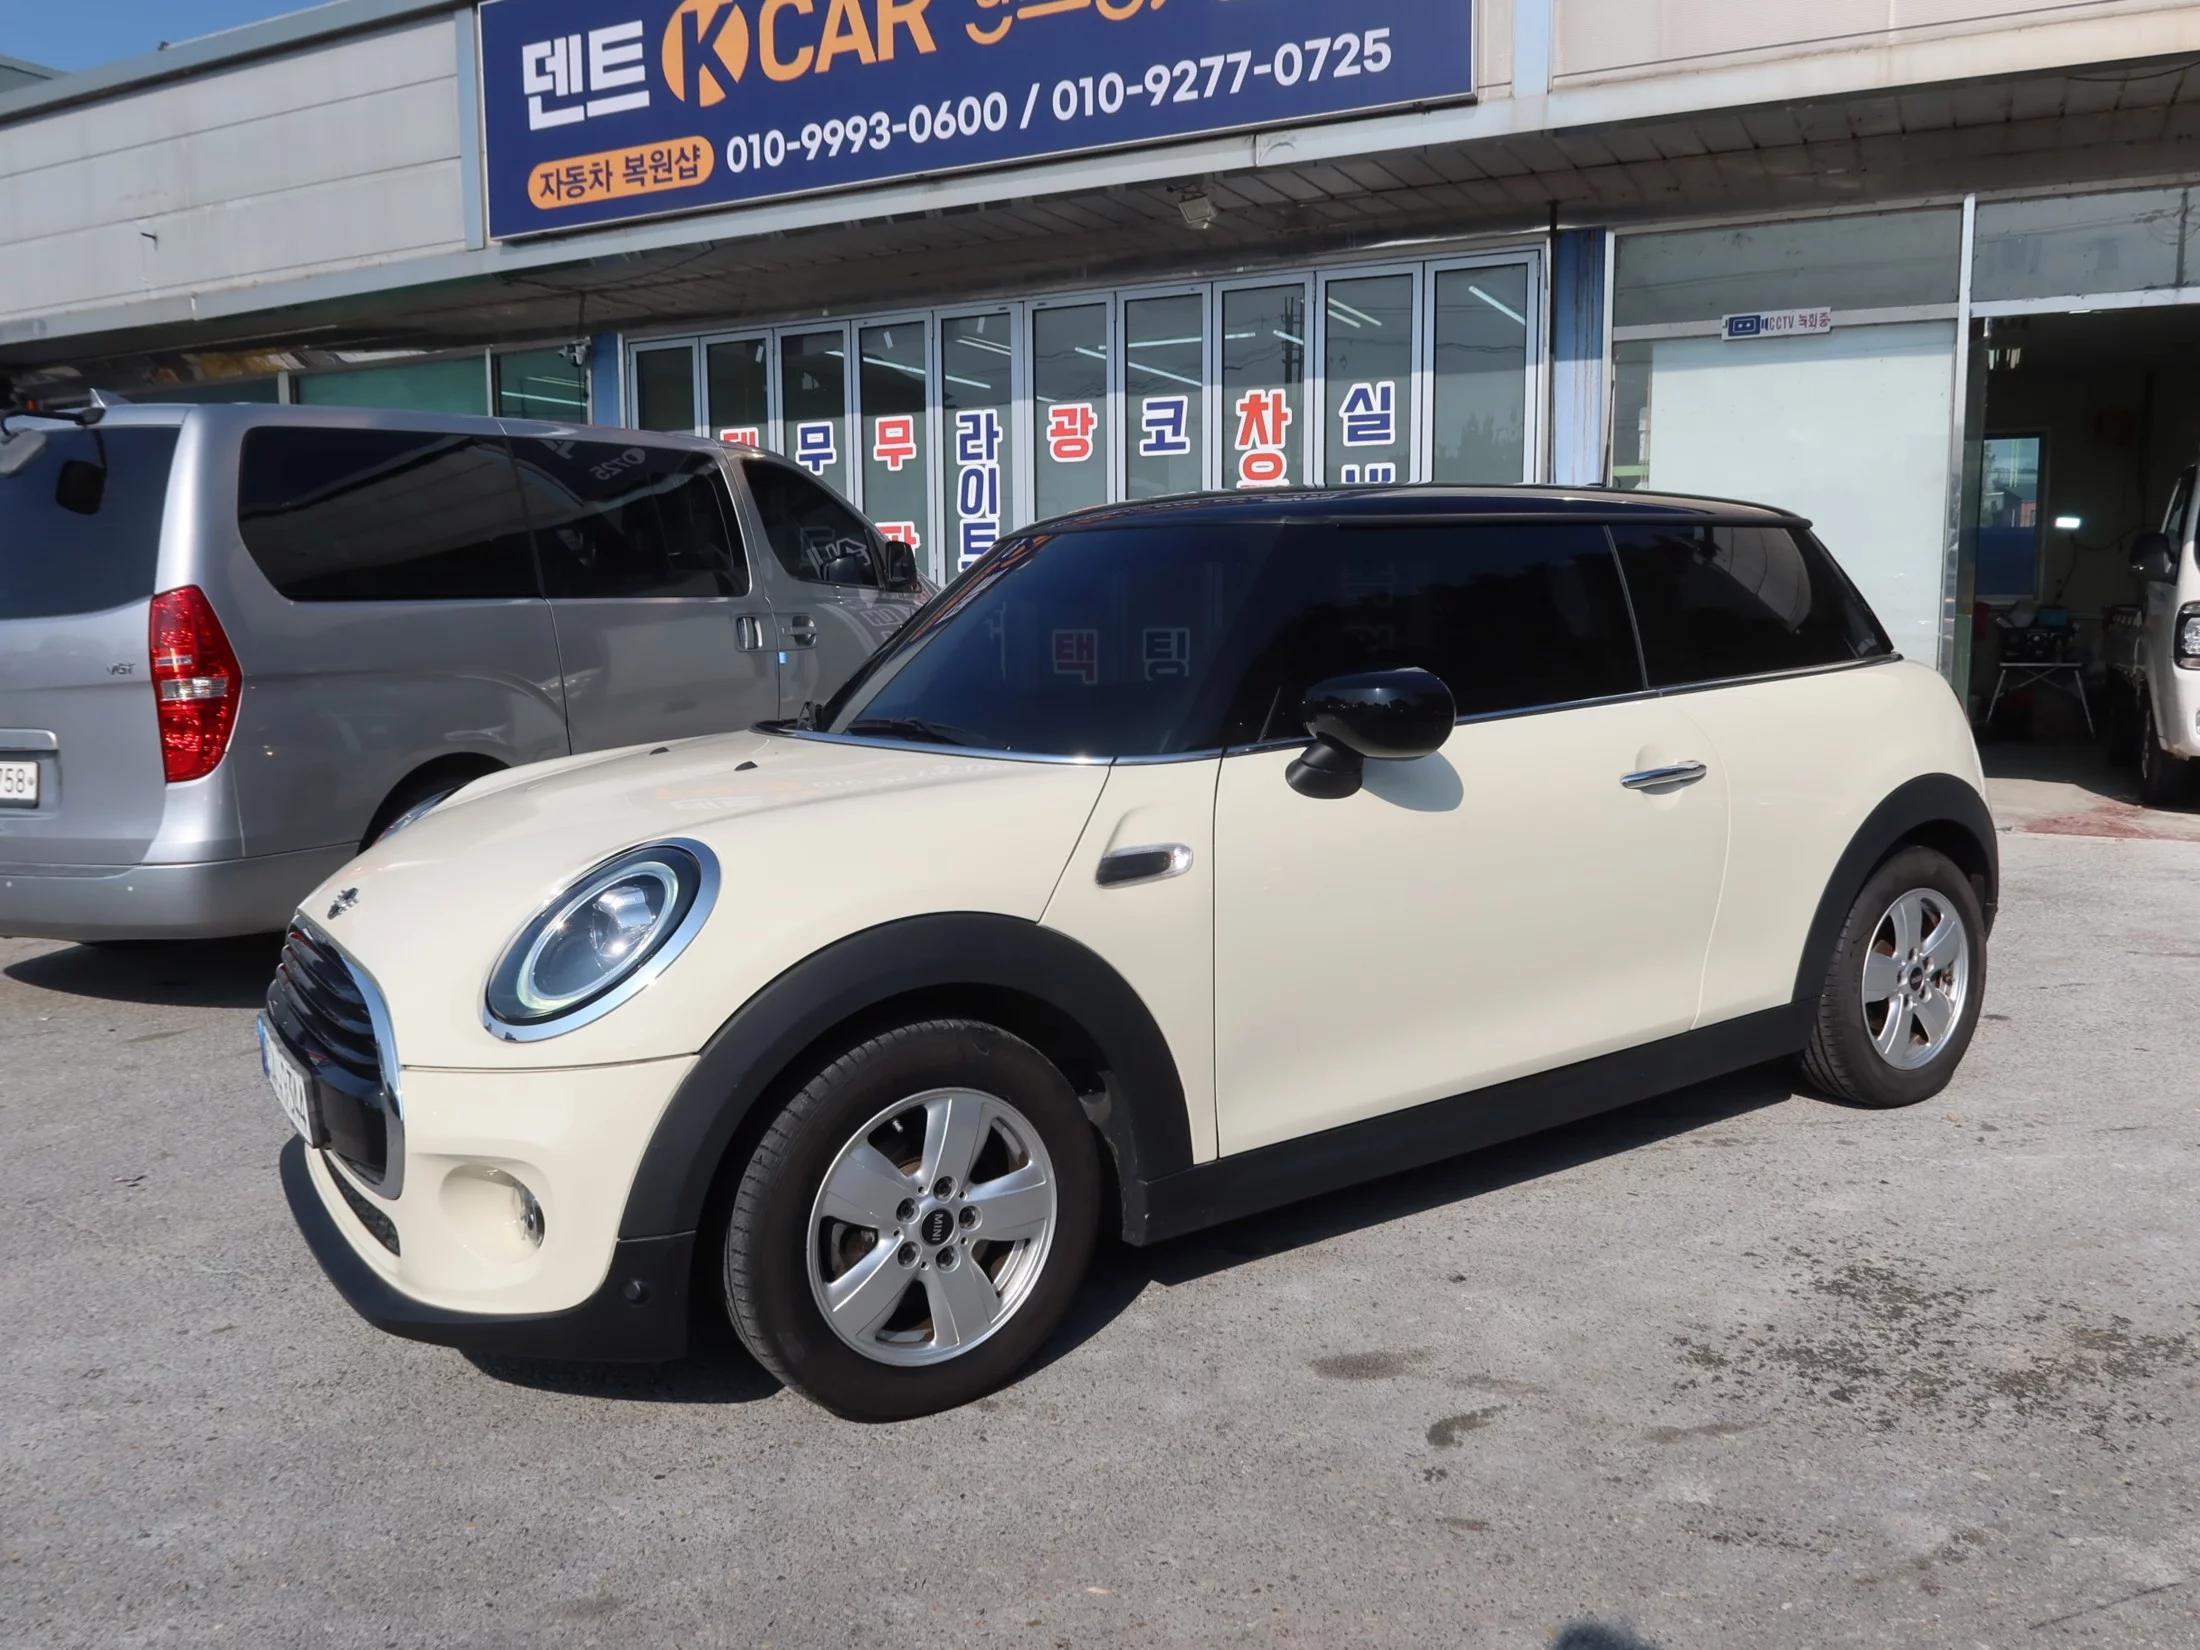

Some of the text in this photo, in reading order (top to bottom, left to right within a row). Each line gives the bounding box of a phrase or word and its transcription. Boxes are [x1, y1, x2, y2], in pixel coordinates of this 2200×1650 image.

[522, 20, 650, 131] 덴트
[726, 91, 1008, 175] 010-9993-0600
[1052, 27, 1392, 121] 010-9277-0725
[539, 147, 702, 202] 자동차 복원샵
[1769, 315, 1795, 331] CCTV
[932, 1213, 944, 1241] MINI
